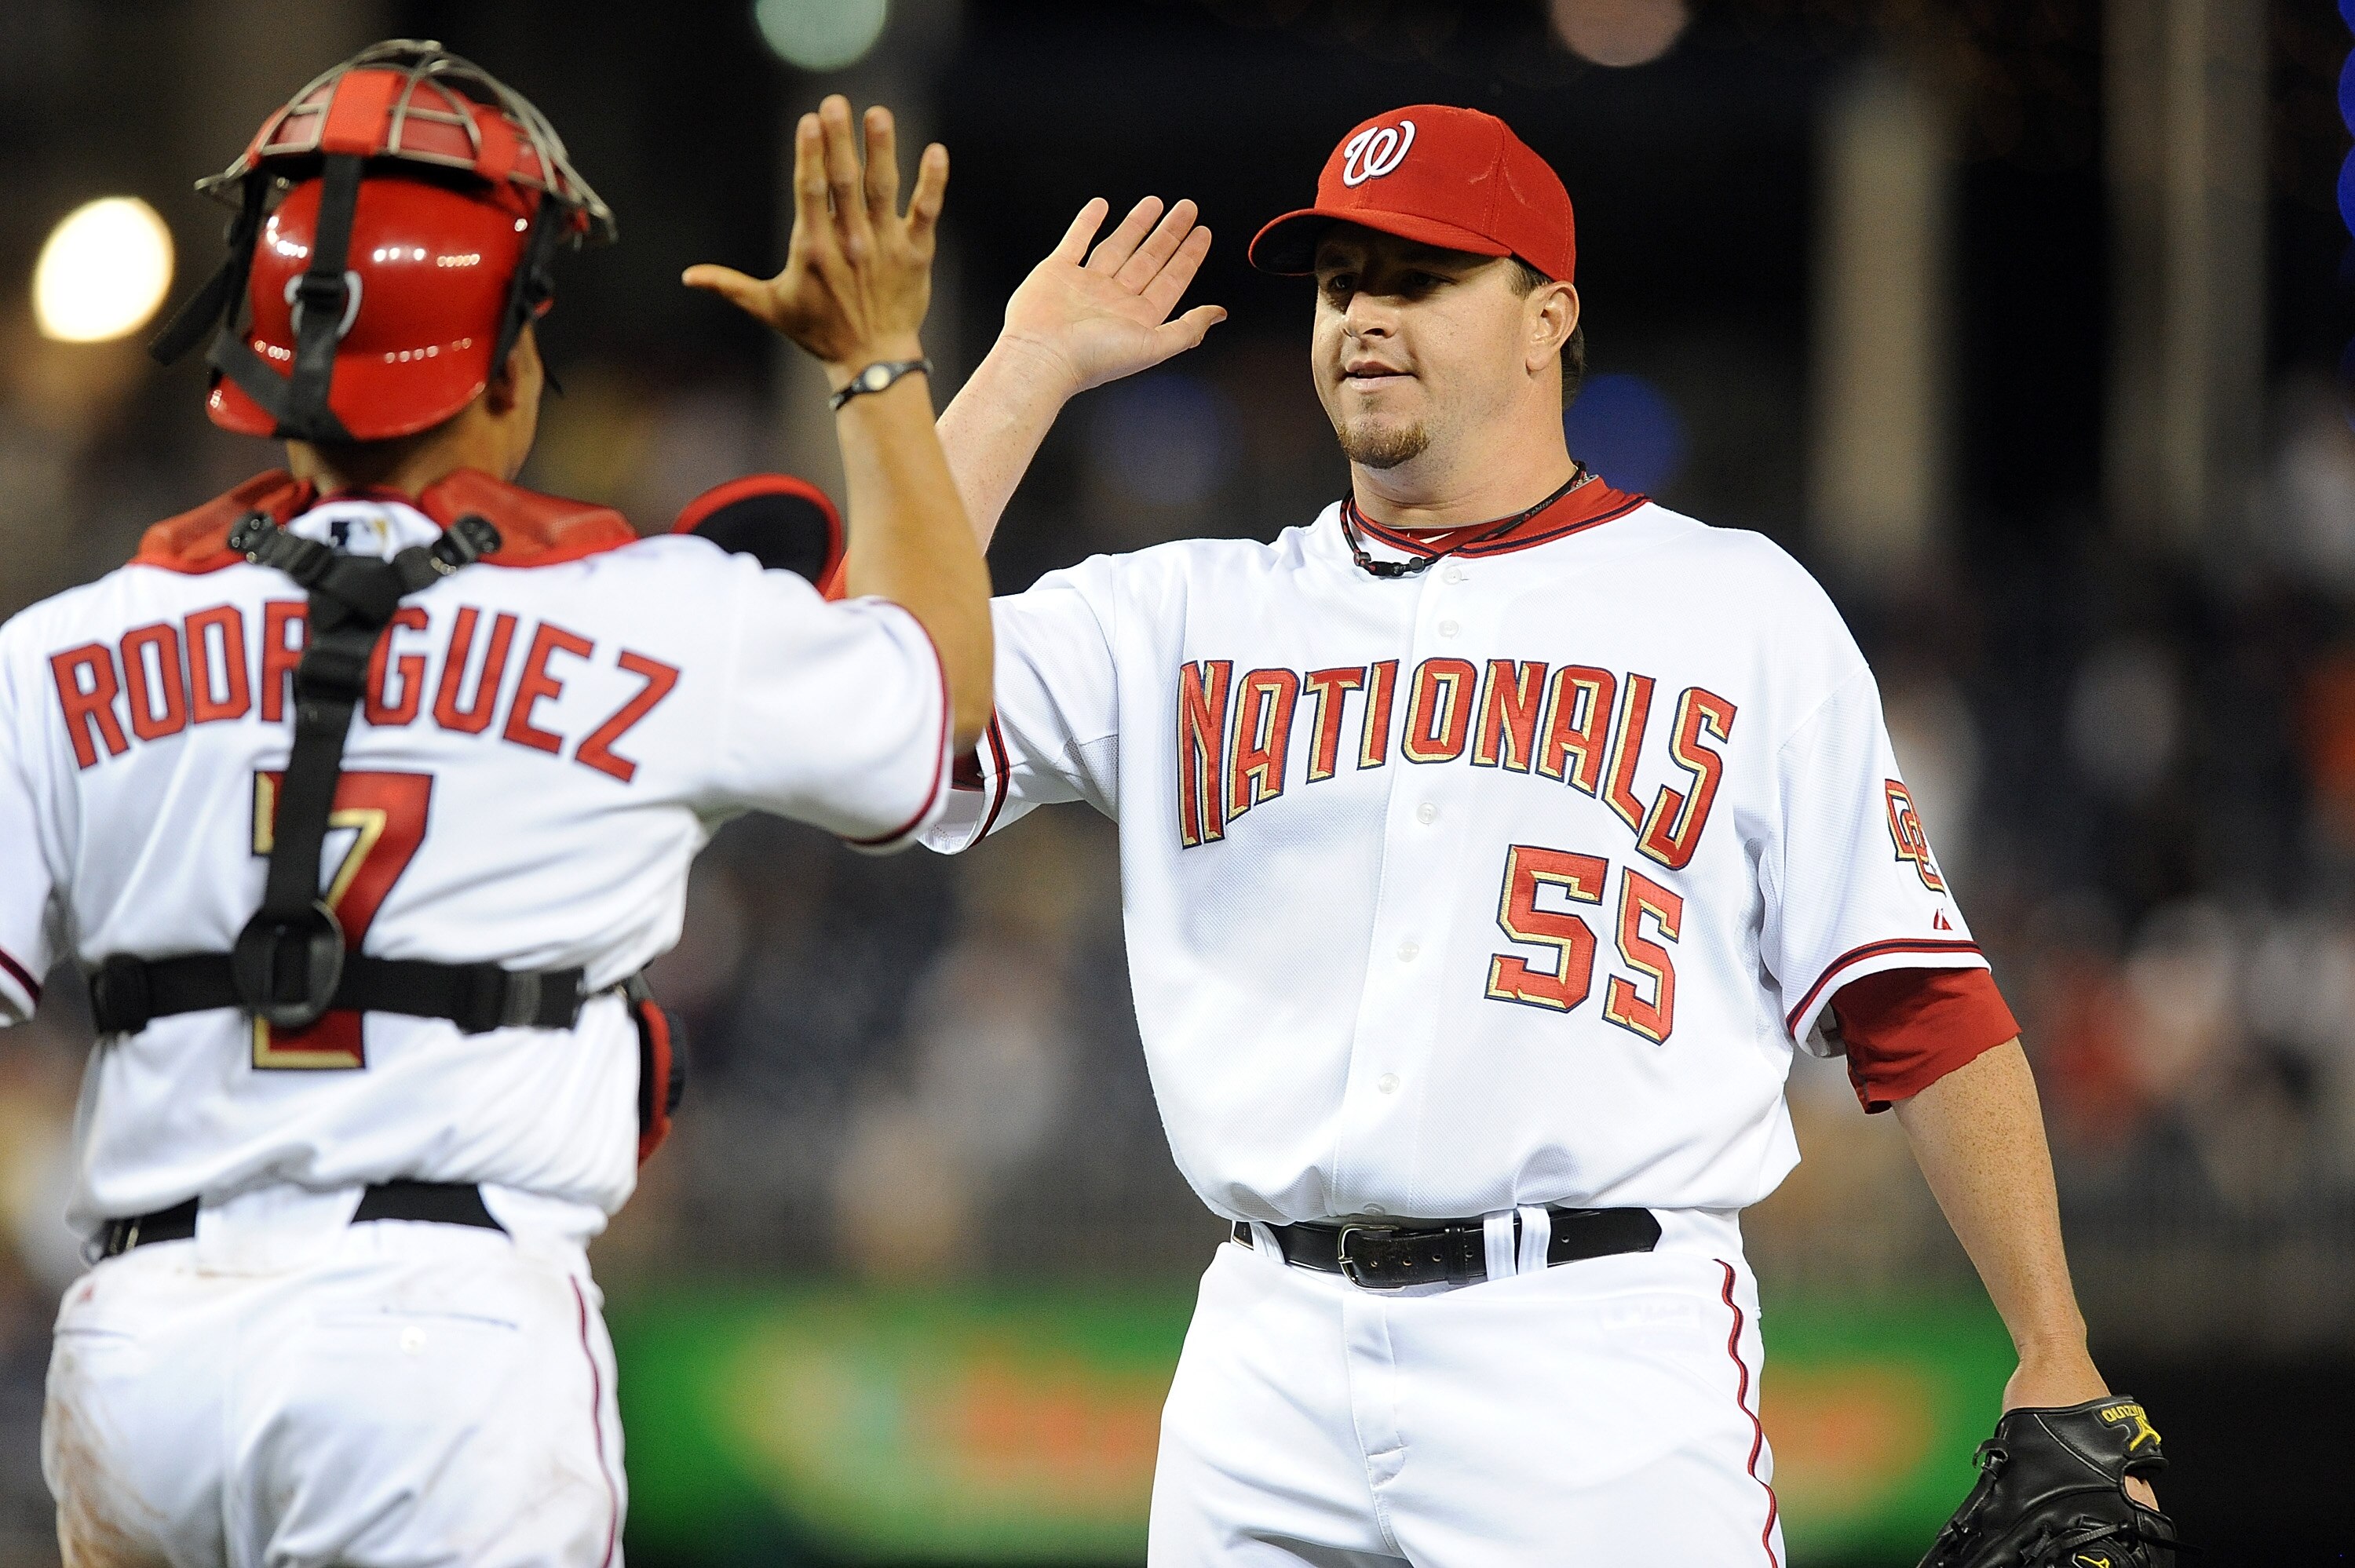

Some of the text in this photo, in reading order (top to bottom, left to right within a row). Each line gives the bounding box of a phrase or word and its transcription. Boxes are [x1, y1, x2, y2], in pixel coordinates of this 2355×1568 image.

[1343, 119, 1416, 188] W
[49, 600, 681, 784] RODRGUEZ
[1177, 657, 1738, 872] NATIONALS
[253, 769, 435, 1070] 7
[1484, 844, 1685, 1046] 55
